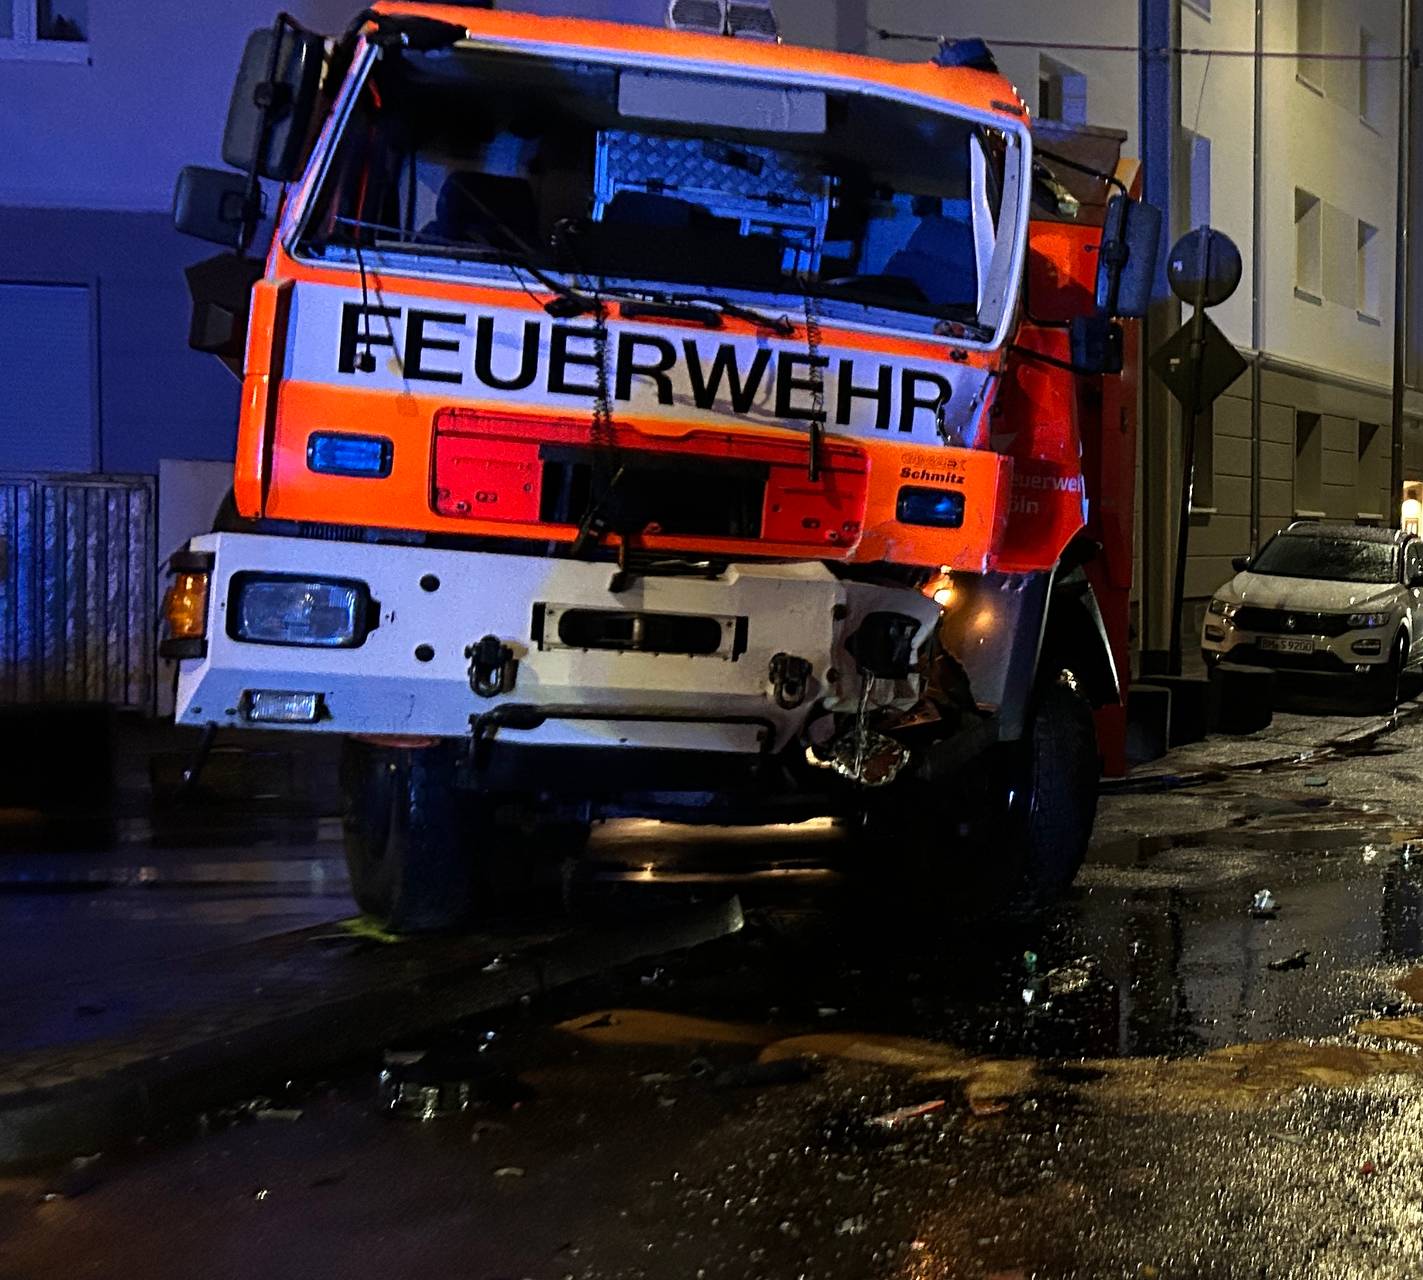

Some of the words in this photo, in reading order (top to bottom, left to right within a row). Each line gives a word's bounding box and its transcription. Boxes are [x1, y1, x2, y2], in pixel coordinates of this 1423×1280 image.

[338, 300, 953, 437] FEUERWEHR
[900, 466, 966, 485] Schmitz
[1010, 473, 1085, 493] euerwe
[1009, 495, 1040, 514] öln
